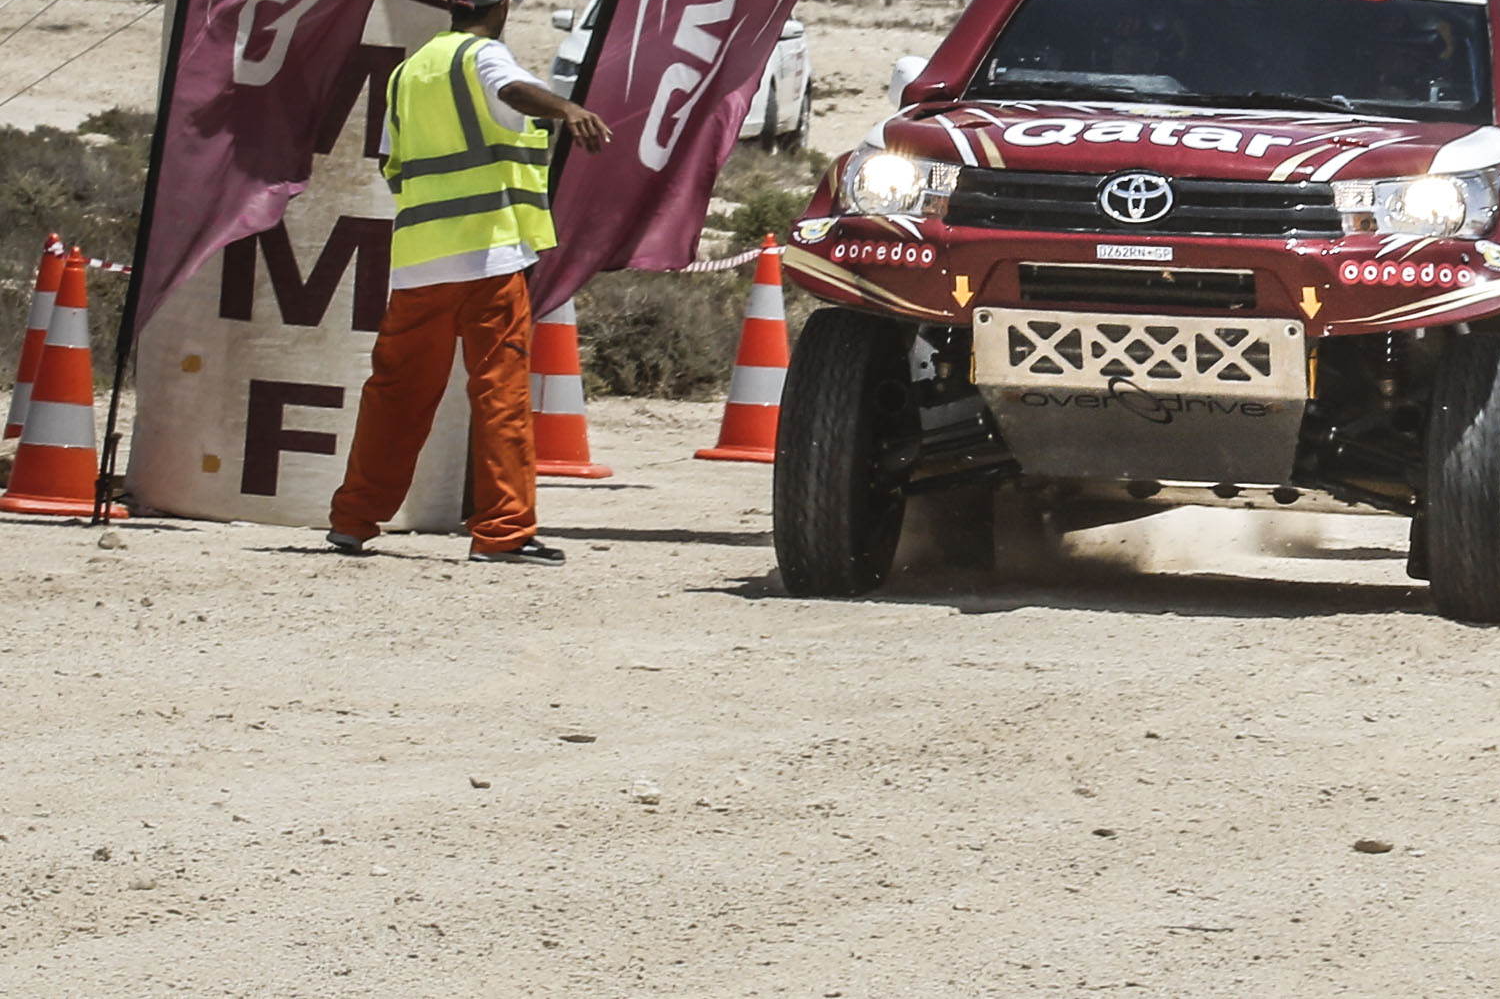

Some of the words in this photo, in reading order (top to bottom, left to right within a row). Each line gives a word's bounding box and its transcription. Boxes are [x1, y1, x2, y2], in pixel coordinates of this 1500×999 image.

[1003, 118, 1292, 157] Qatar
[834, 241, 933, 264] ooredoo
[1343, 263, 1473, 283] ooredoo
